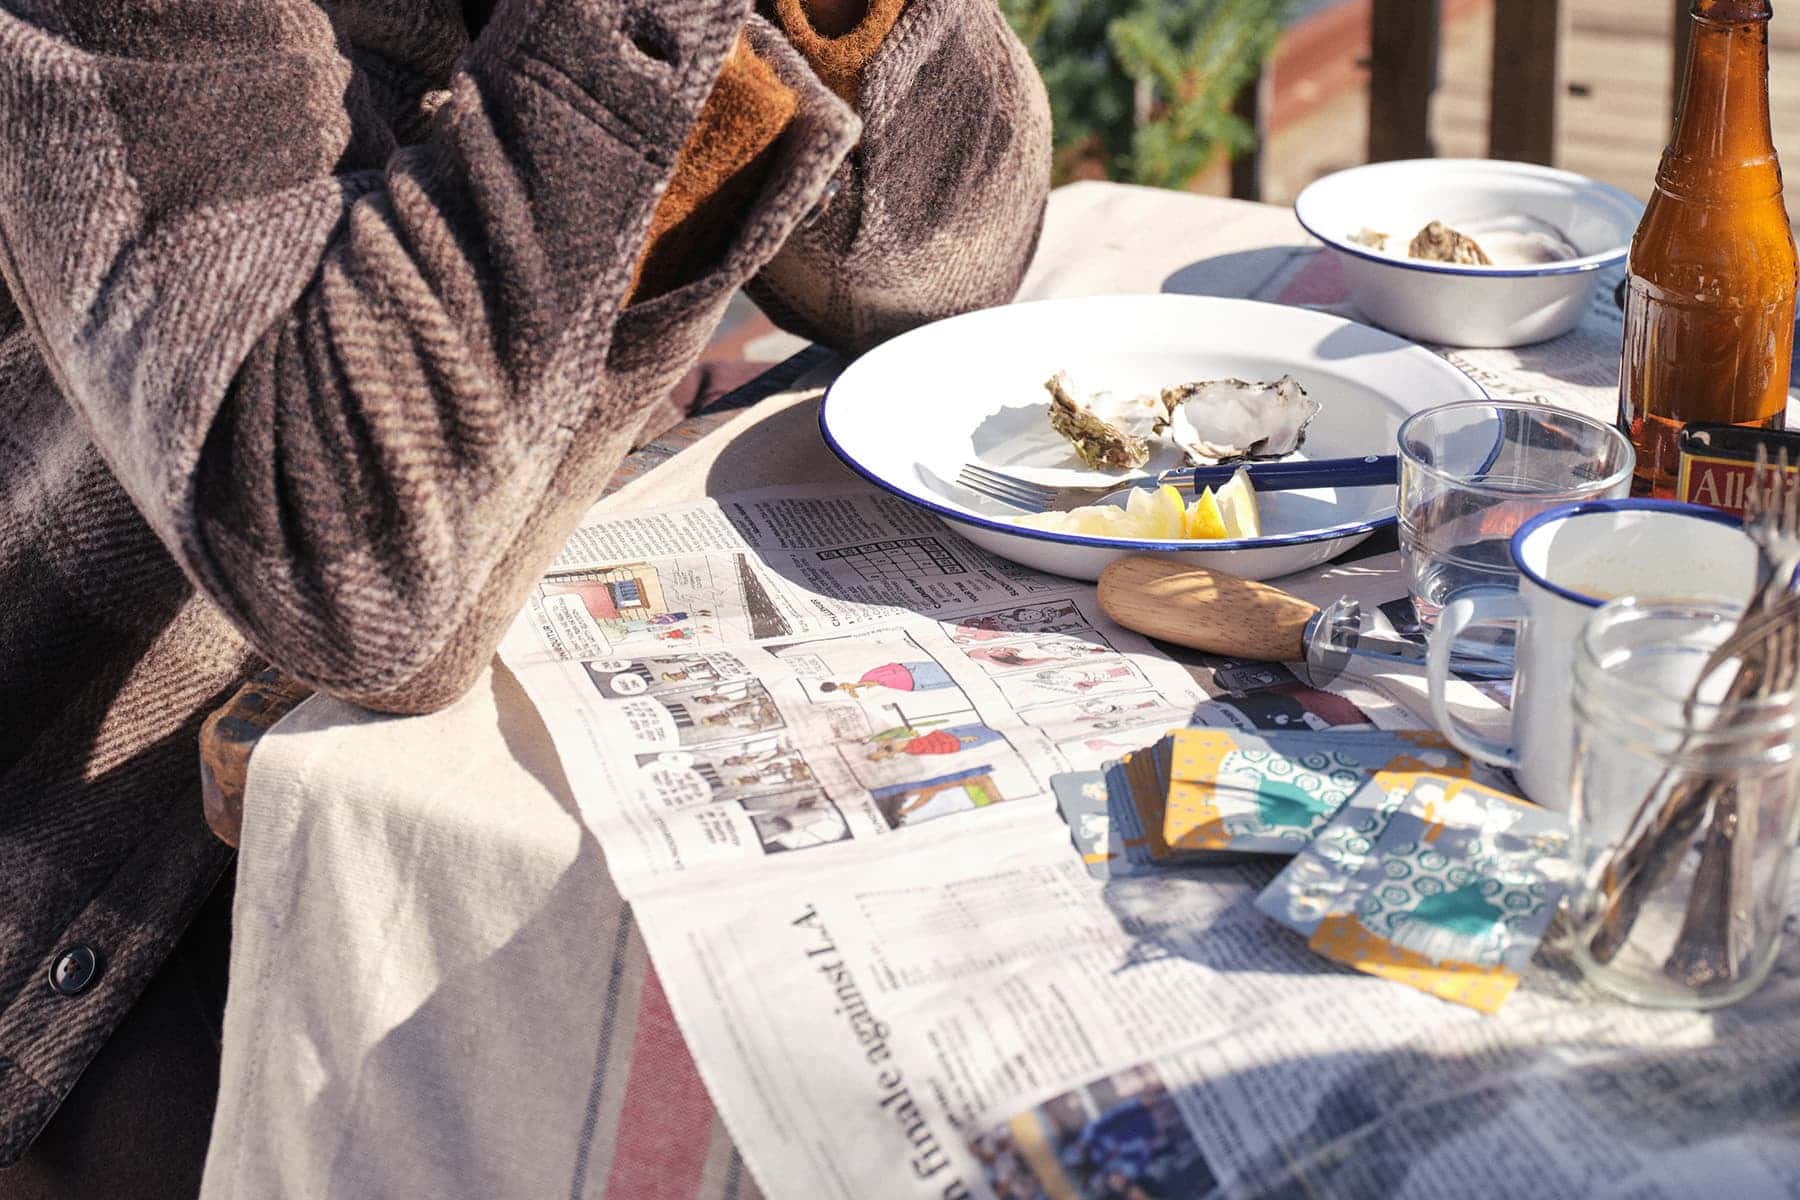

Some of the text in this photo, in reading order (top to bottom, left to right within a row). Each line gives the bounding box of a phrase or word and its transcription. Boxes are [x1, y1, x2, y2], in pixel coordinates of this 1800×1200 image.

[791, 901, 951, 1179] finale against L.A.
